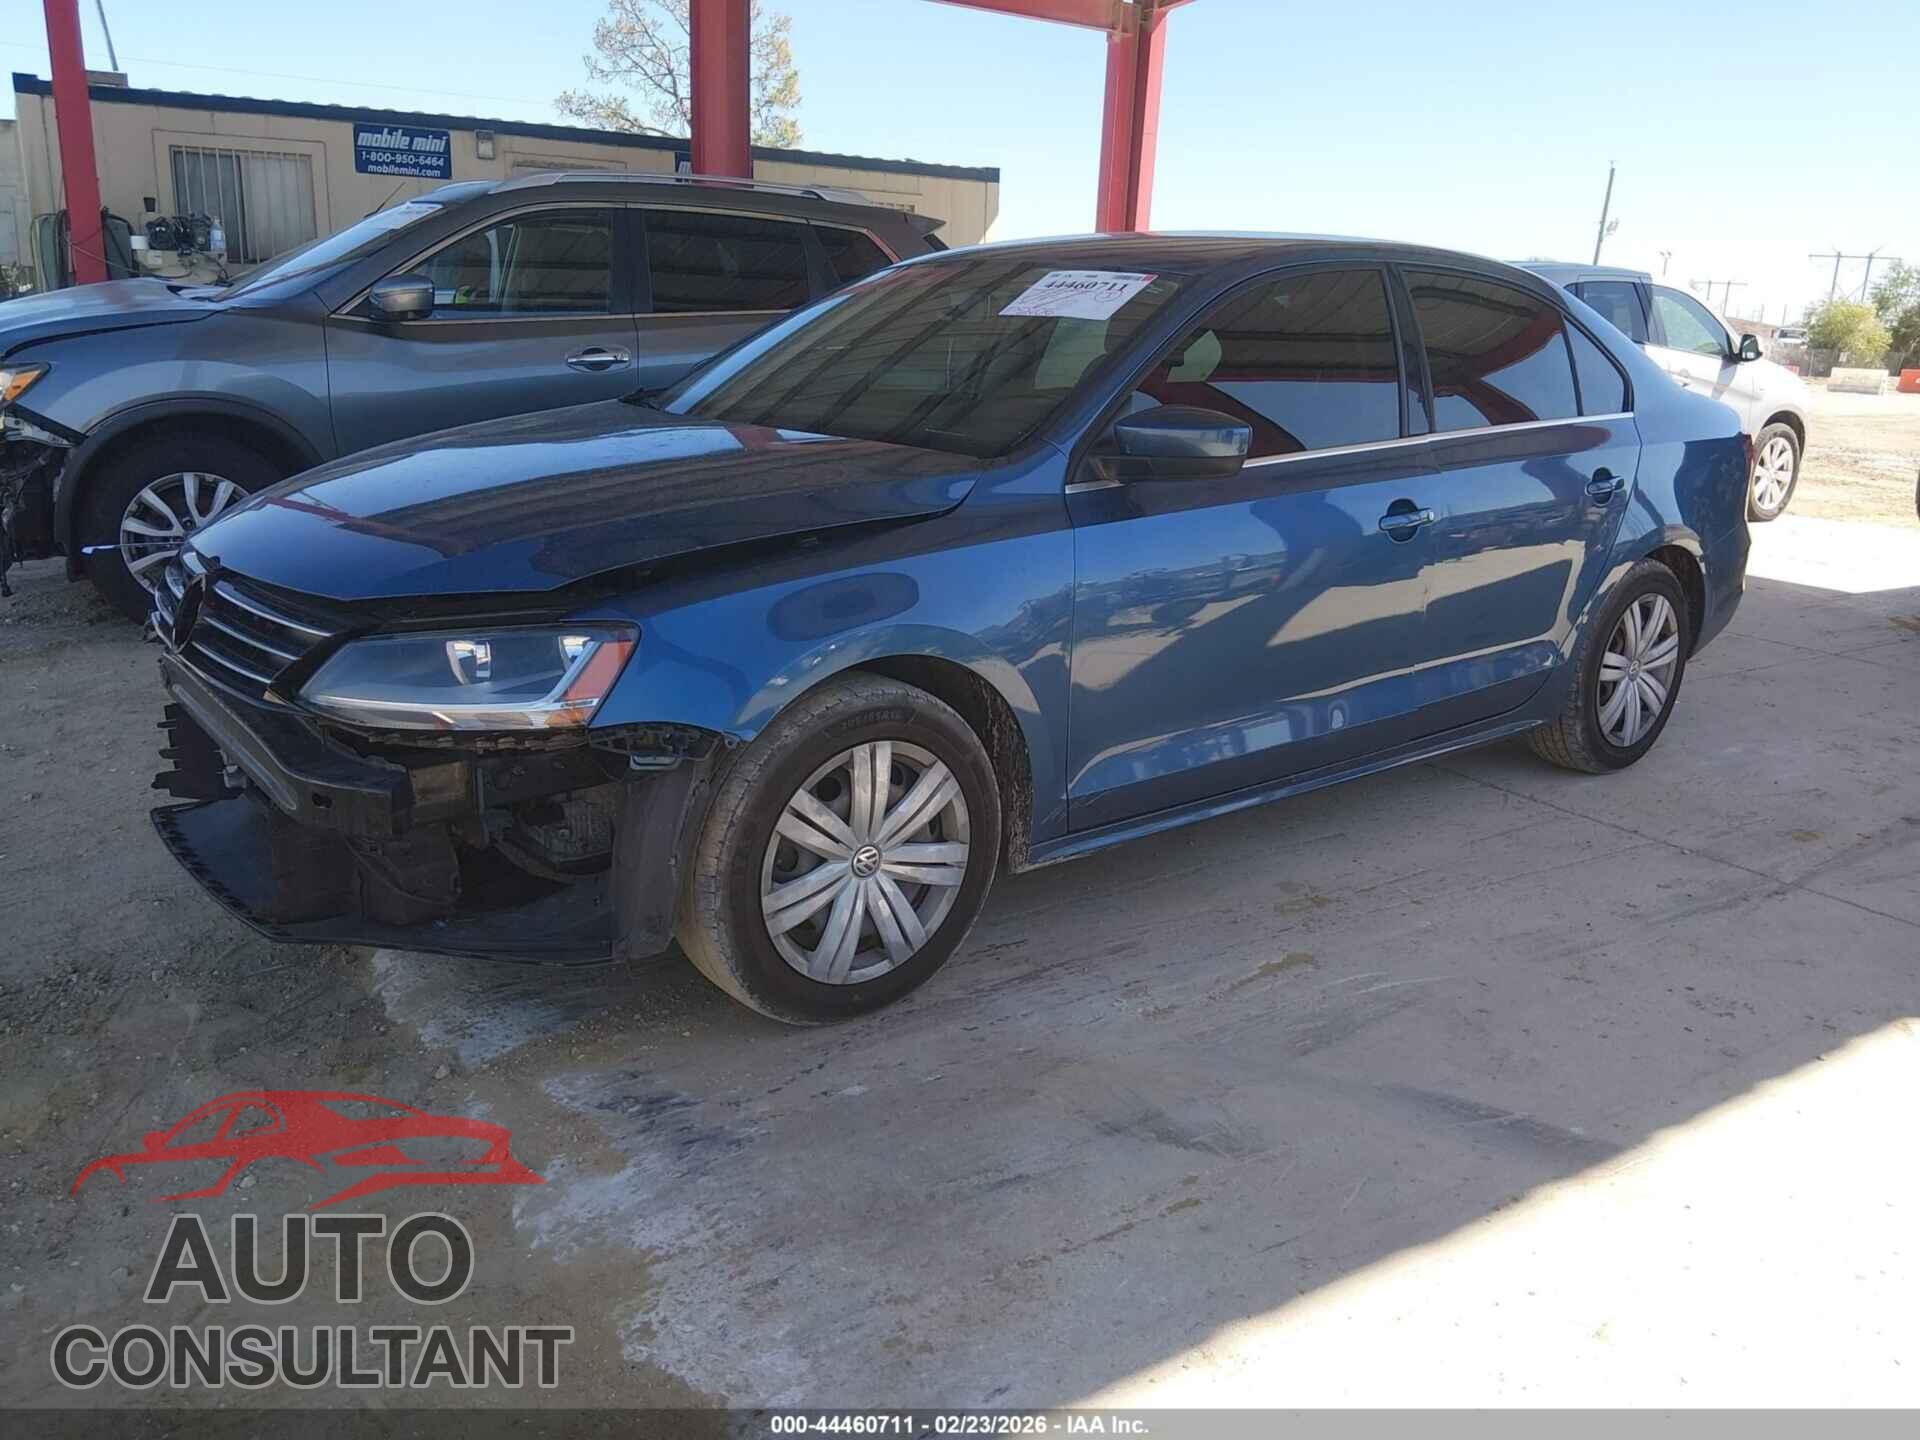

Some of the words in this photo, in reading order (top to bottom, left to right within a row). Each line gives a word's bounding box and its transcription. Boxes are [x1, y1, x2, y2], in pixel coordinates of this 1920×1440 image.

[358, 128, 410, 150] mobile
[411, 135, 448, 152] mini
[361, 151, 444, 167] 1-800-950-6464
[367, 164, 441, 177] mobilemini.com
[1045, 280, 1129, 291] 44460711
